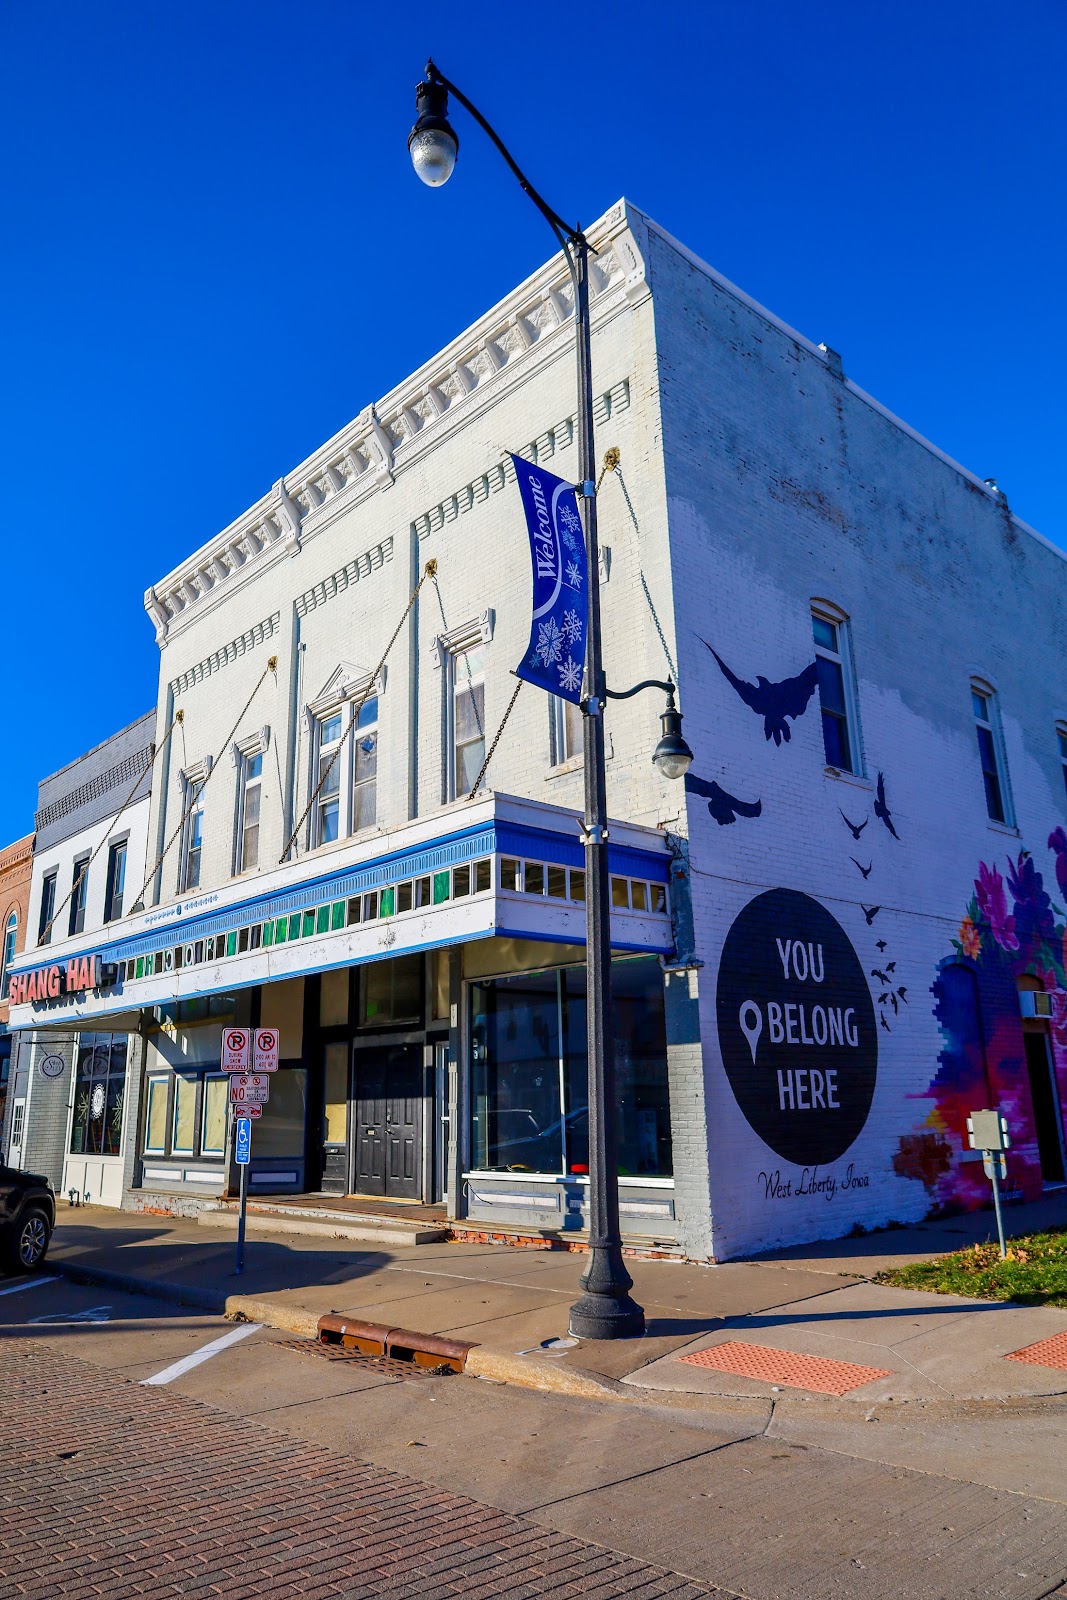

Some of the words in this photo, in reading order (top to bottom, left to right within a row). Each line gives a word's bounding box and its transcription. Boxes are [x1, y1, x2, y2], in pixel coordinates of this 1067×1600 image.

[528, 475, 557, 579] Welcome
[9, 965, 60, 1006] SHANG
[66, 955, 97, 992] HAI
[776, 938, 824, 982] YOU
[767, 1002, 859, 1047] BELONG
[231, 1087, 245, 1101] NO
[777, 1069, 840, 1111] HERE
[757, 1170, 792, 1199] West
[795, 1165, 838, 1201] Liberty,
[841, 1163, 869, 1190] Iowa
